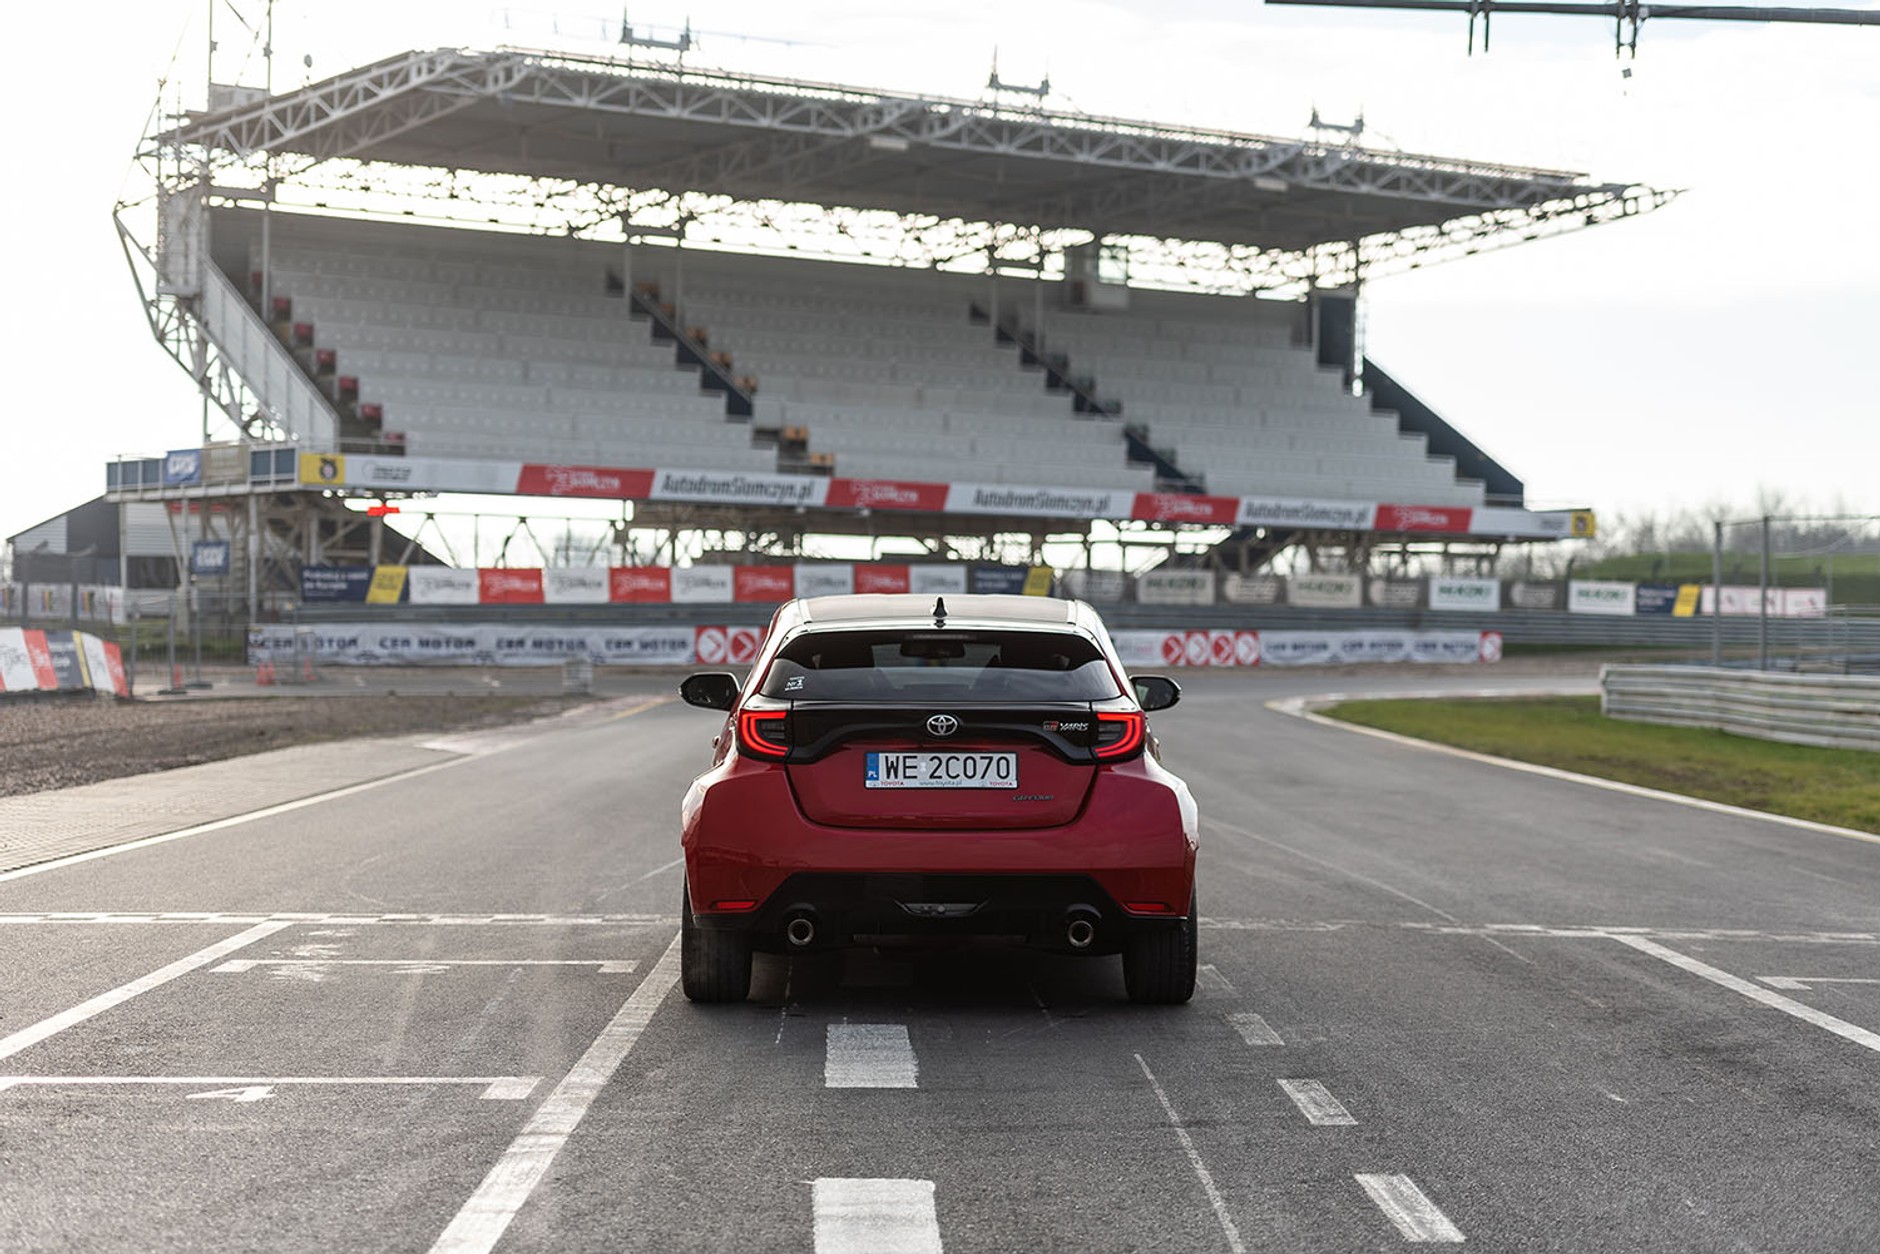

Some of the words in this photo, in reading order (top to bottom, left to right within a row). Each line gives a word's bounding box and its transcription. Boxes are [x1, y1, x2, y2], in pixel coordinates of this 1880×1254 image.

[1060, 722, 1089, 731] YARIS
[885, 755, 918, 779] WE
[929, 755, 1010, 779] 2C070
